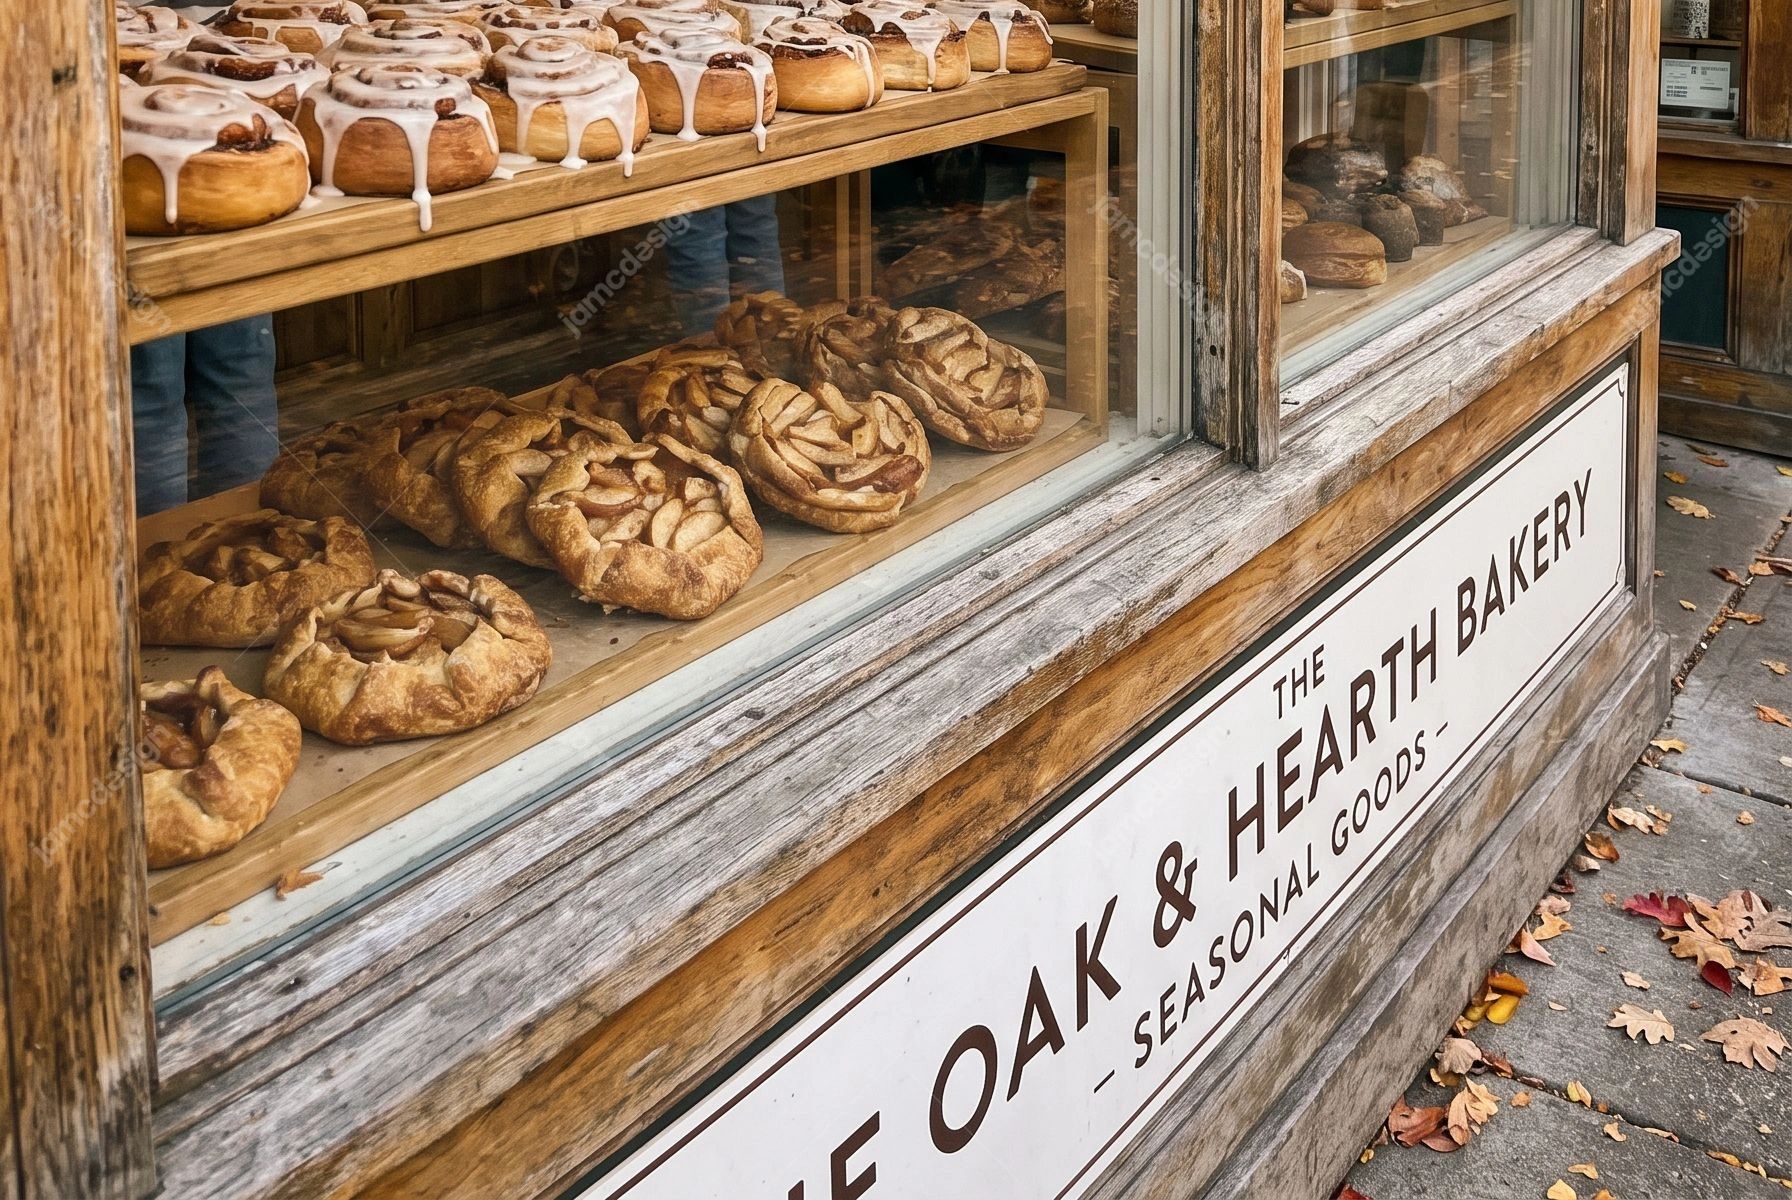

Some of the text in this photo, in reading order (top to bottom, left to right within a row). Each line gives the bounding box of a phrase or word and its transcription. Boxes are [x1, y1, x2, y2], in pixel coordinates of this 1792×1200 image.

[928, 894, 1122, 1154] OAK
[1152, 840, 1198, 949] &
[1228, 607, 1437, 883] HEARTH
[1457, 467, 1592, 657] BAKERY
[1272, 643, 1326, 720] THE
[1133, 842, 1321, 1069] SEASONAL
[1331, 729, 1426, 857] GOODS
